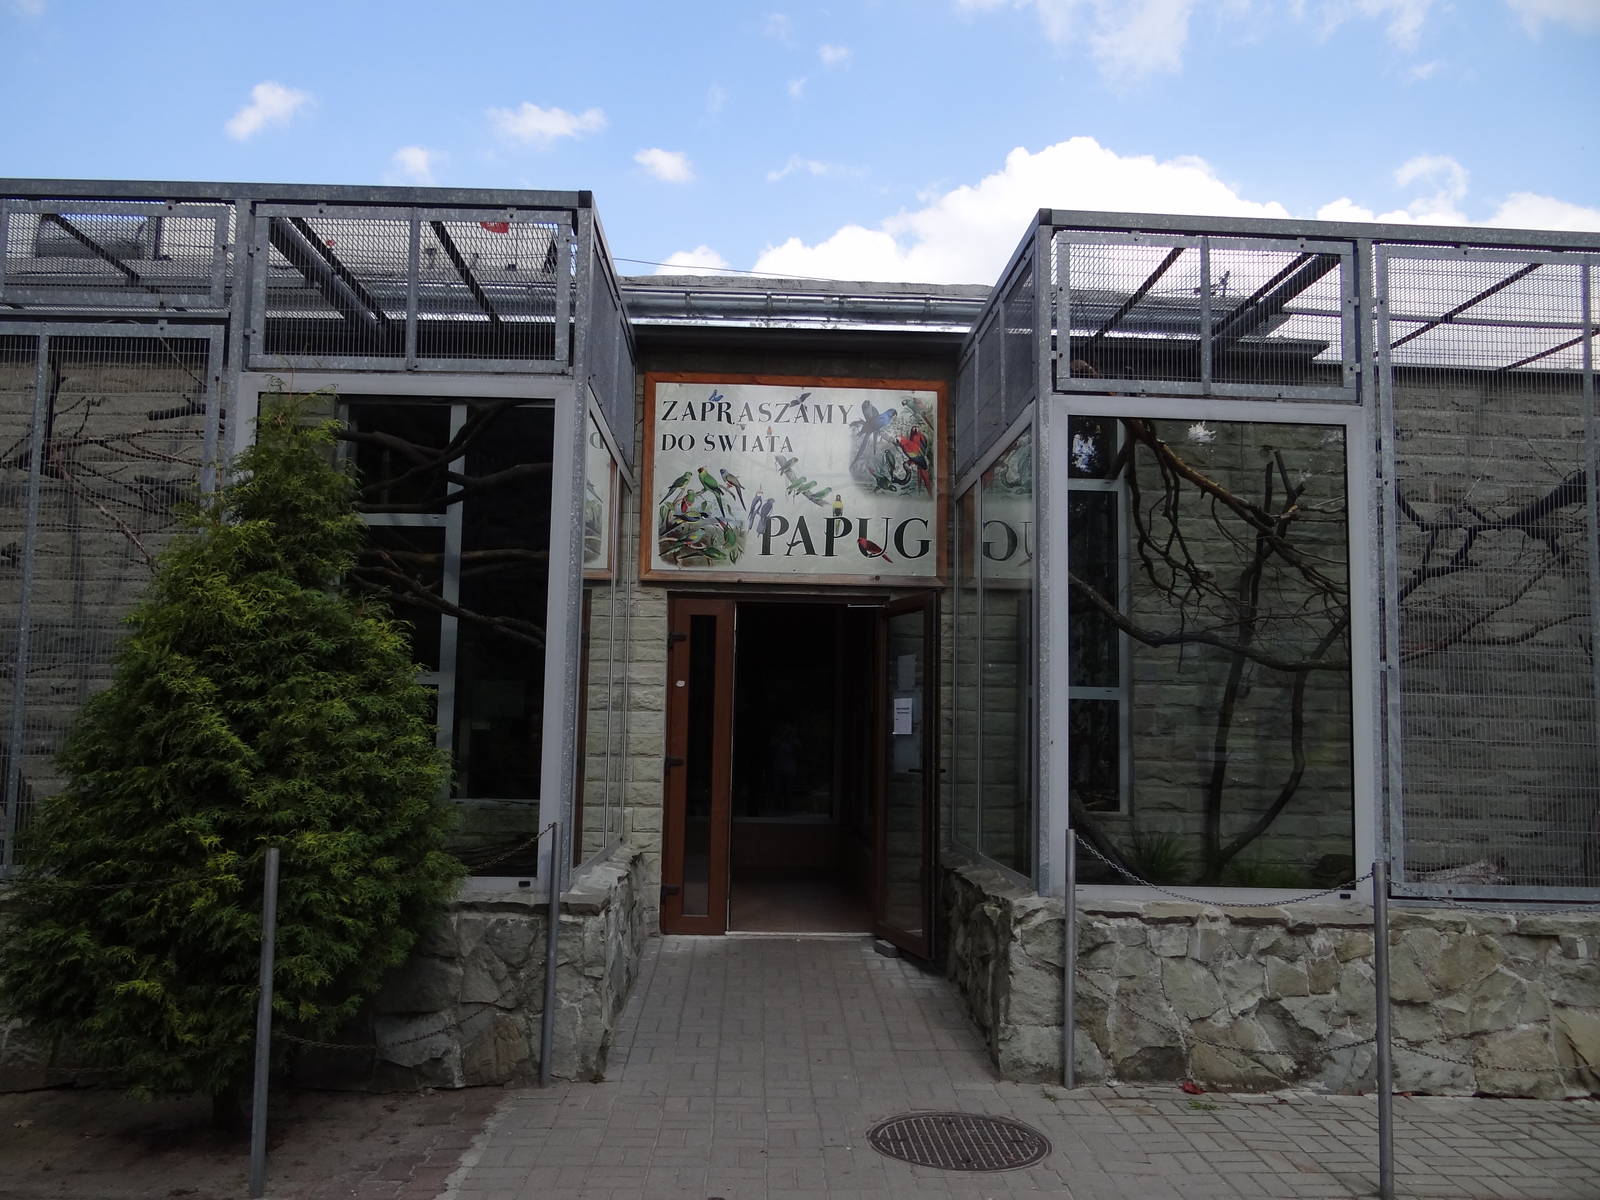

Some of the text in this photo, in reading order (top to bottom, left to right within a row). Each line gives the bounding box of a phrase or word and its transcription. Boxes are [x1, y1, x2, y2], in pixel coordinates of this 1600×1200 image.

[661, 400, 854, 425] ZAPRASZAMY
[661, 432, 793, 453] DO ŚWIATA
[757, 515, 933, 559] PAPUG
